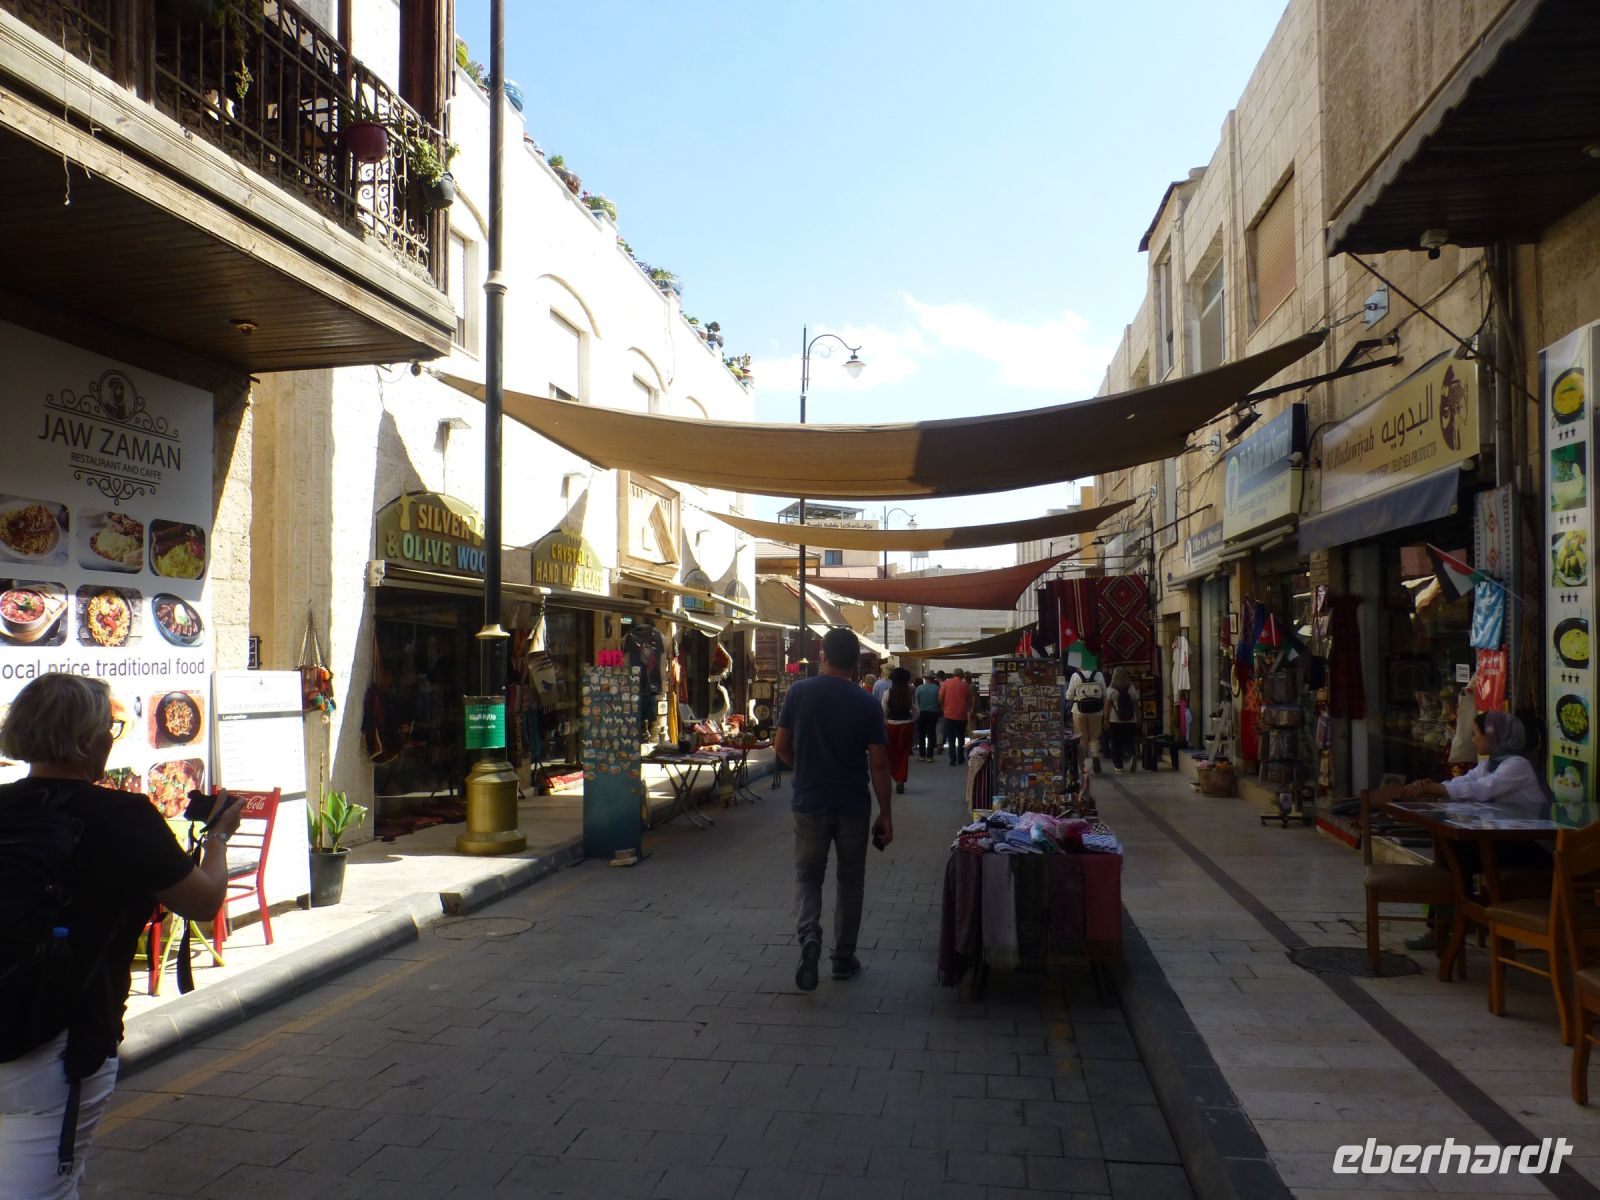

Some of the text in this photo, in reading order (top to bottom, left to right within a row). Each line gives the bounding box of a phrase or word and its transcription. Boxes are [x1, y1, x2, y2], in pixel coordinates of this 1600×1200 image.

[38, 413, 181, 471] JAW ZAMAN
[71, 452, 163, 480] RESTAURANT AND CAFFE
[417, 503, 470, 540] SILVER
[386, 529, 486, 573] & OLIVE WOO
[551, 543, 585, 566] CRYSTAL
[535, 560, 559, 584] HAND
[1, 659, 41, 679] ocal
[96, 657, 171, 677] traditional
[176, 657, 205, 675] food
